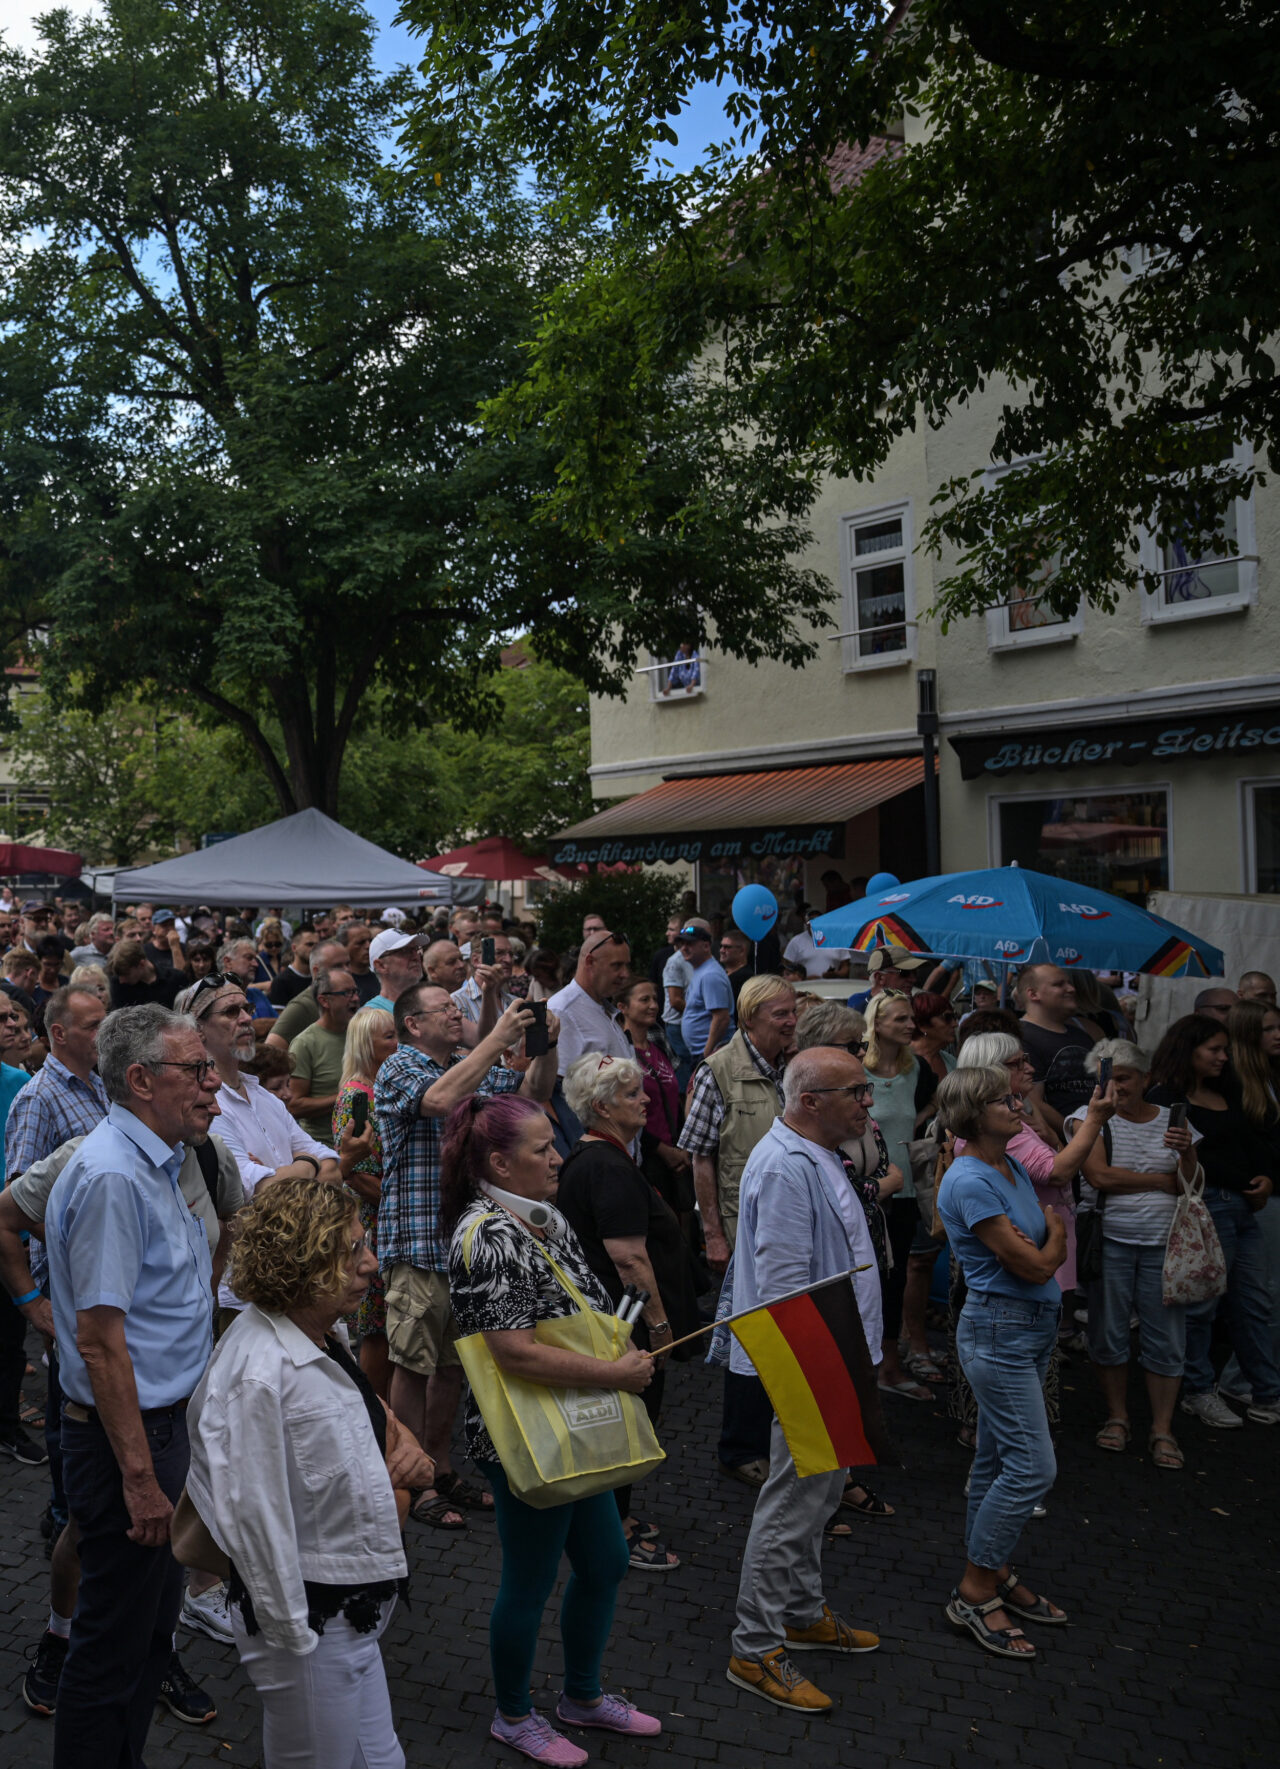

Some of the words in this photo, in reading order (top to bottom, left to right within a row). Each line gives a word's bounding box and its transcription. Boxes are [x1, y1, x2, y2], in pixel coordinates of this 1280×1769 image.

[554, 840, 703, 864] Buchhandlung
[710, 840, 741, 856] am
[750, 829, 833, 854] Markt
[947, 894, 994, 906] AfD
[1058, 903, 1099, 915] AfD
[994, 940, 1019, 953] AfD
[1056, 947, 1079, 960] AfD
[575, 1405, 612, 1423] ALDI
